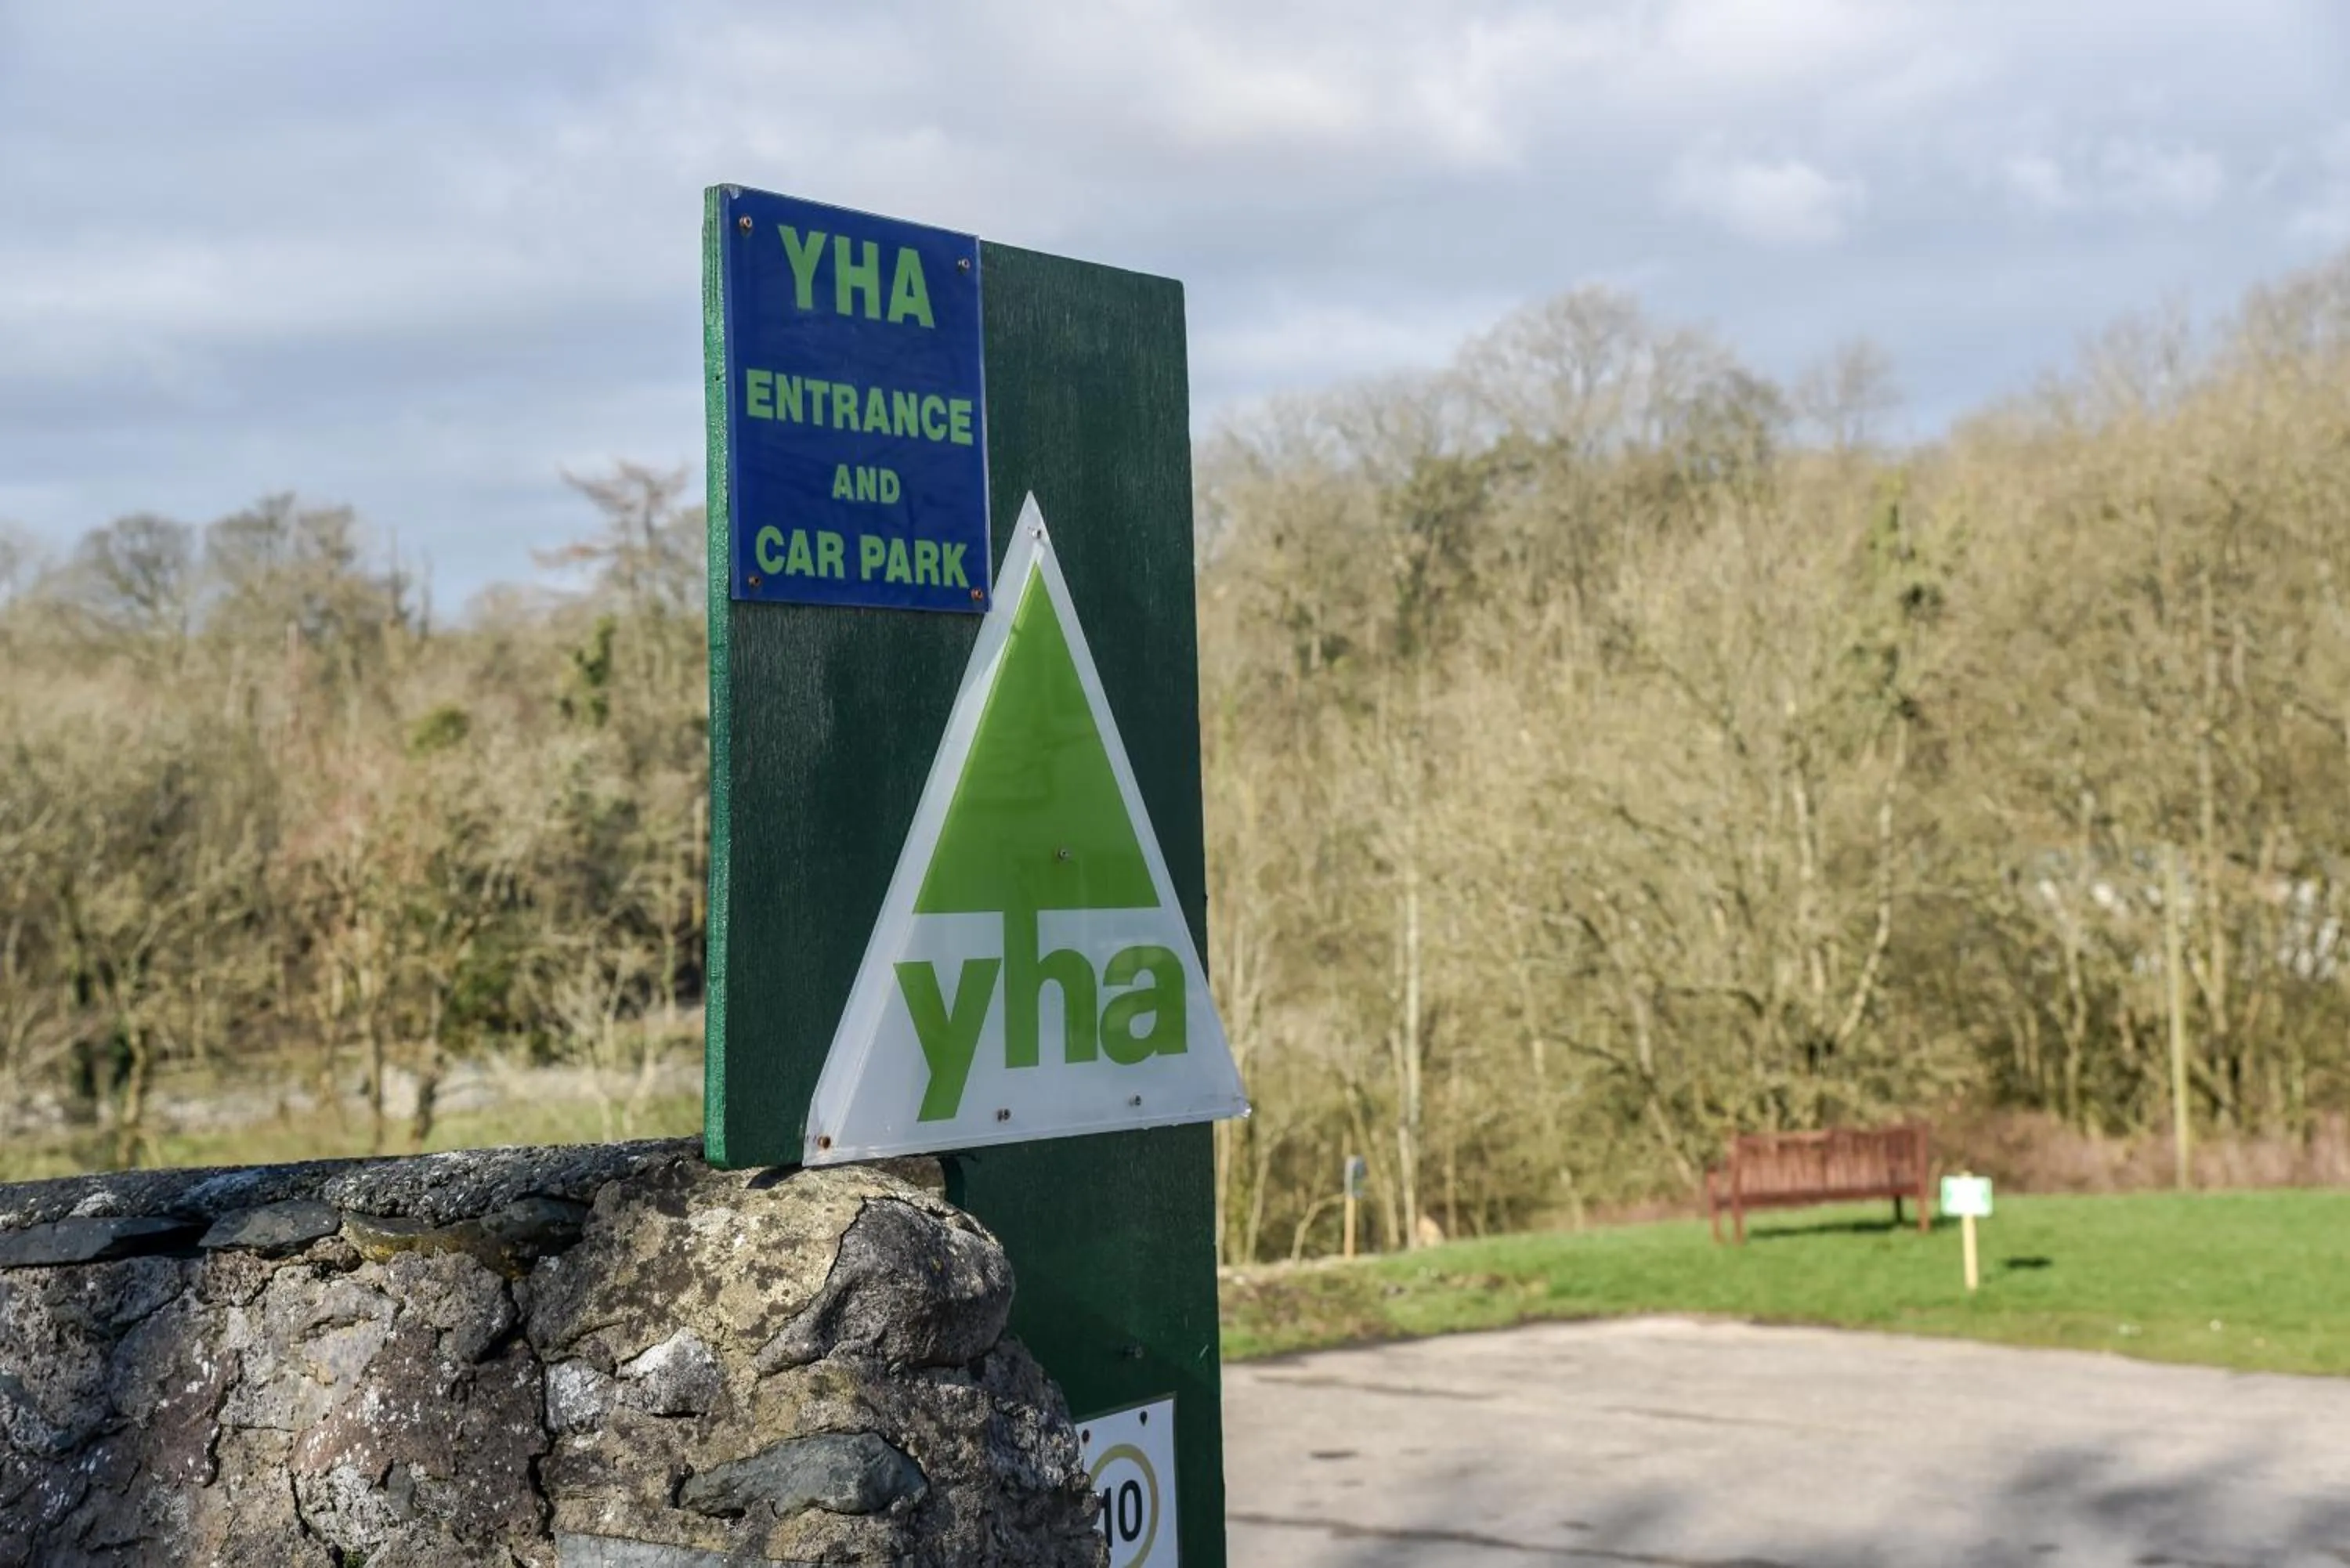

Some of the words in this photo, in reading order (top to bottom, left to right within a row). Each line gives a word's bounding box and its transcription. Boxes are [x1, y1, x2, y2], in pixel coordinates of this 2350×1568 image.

[777, 224, 935, 329] YHA
[746, 368, 974, 446] ENTRANCE
[832, 464, 900, 504] AND
[755, 525, 845, 580] CAR
[860, 533, 970, 588] PARK
[892, 909, 1188, 1123] yha
[1101, 1479, 1143, 1548] 10
